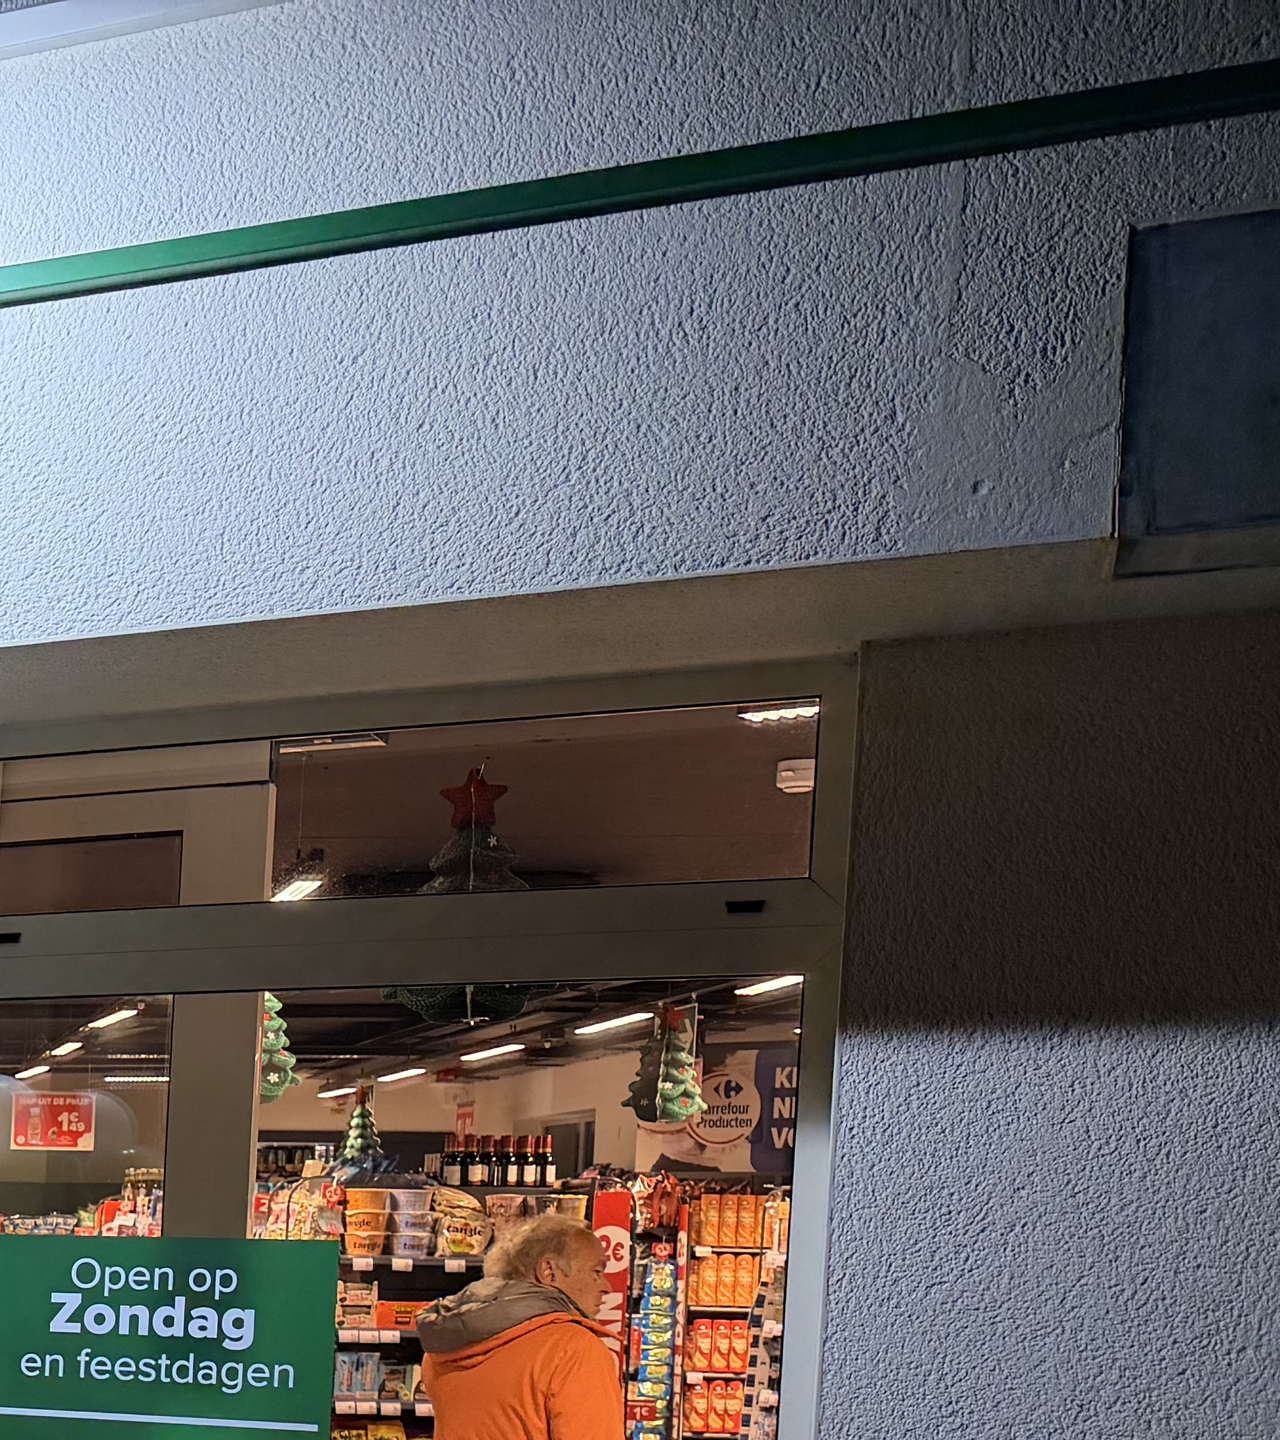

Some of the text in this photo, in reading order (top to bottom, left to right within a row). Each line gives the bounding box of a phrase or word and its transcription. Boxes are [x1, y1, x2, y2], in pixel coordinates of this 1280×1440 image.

[702, 1102, 750, 1115] arrefour
[71, 1257, 238, 1300] Open op
[49, 1292, 256, 1351] Zondag
[20, 1348, 296, 1394] en feestdagen
